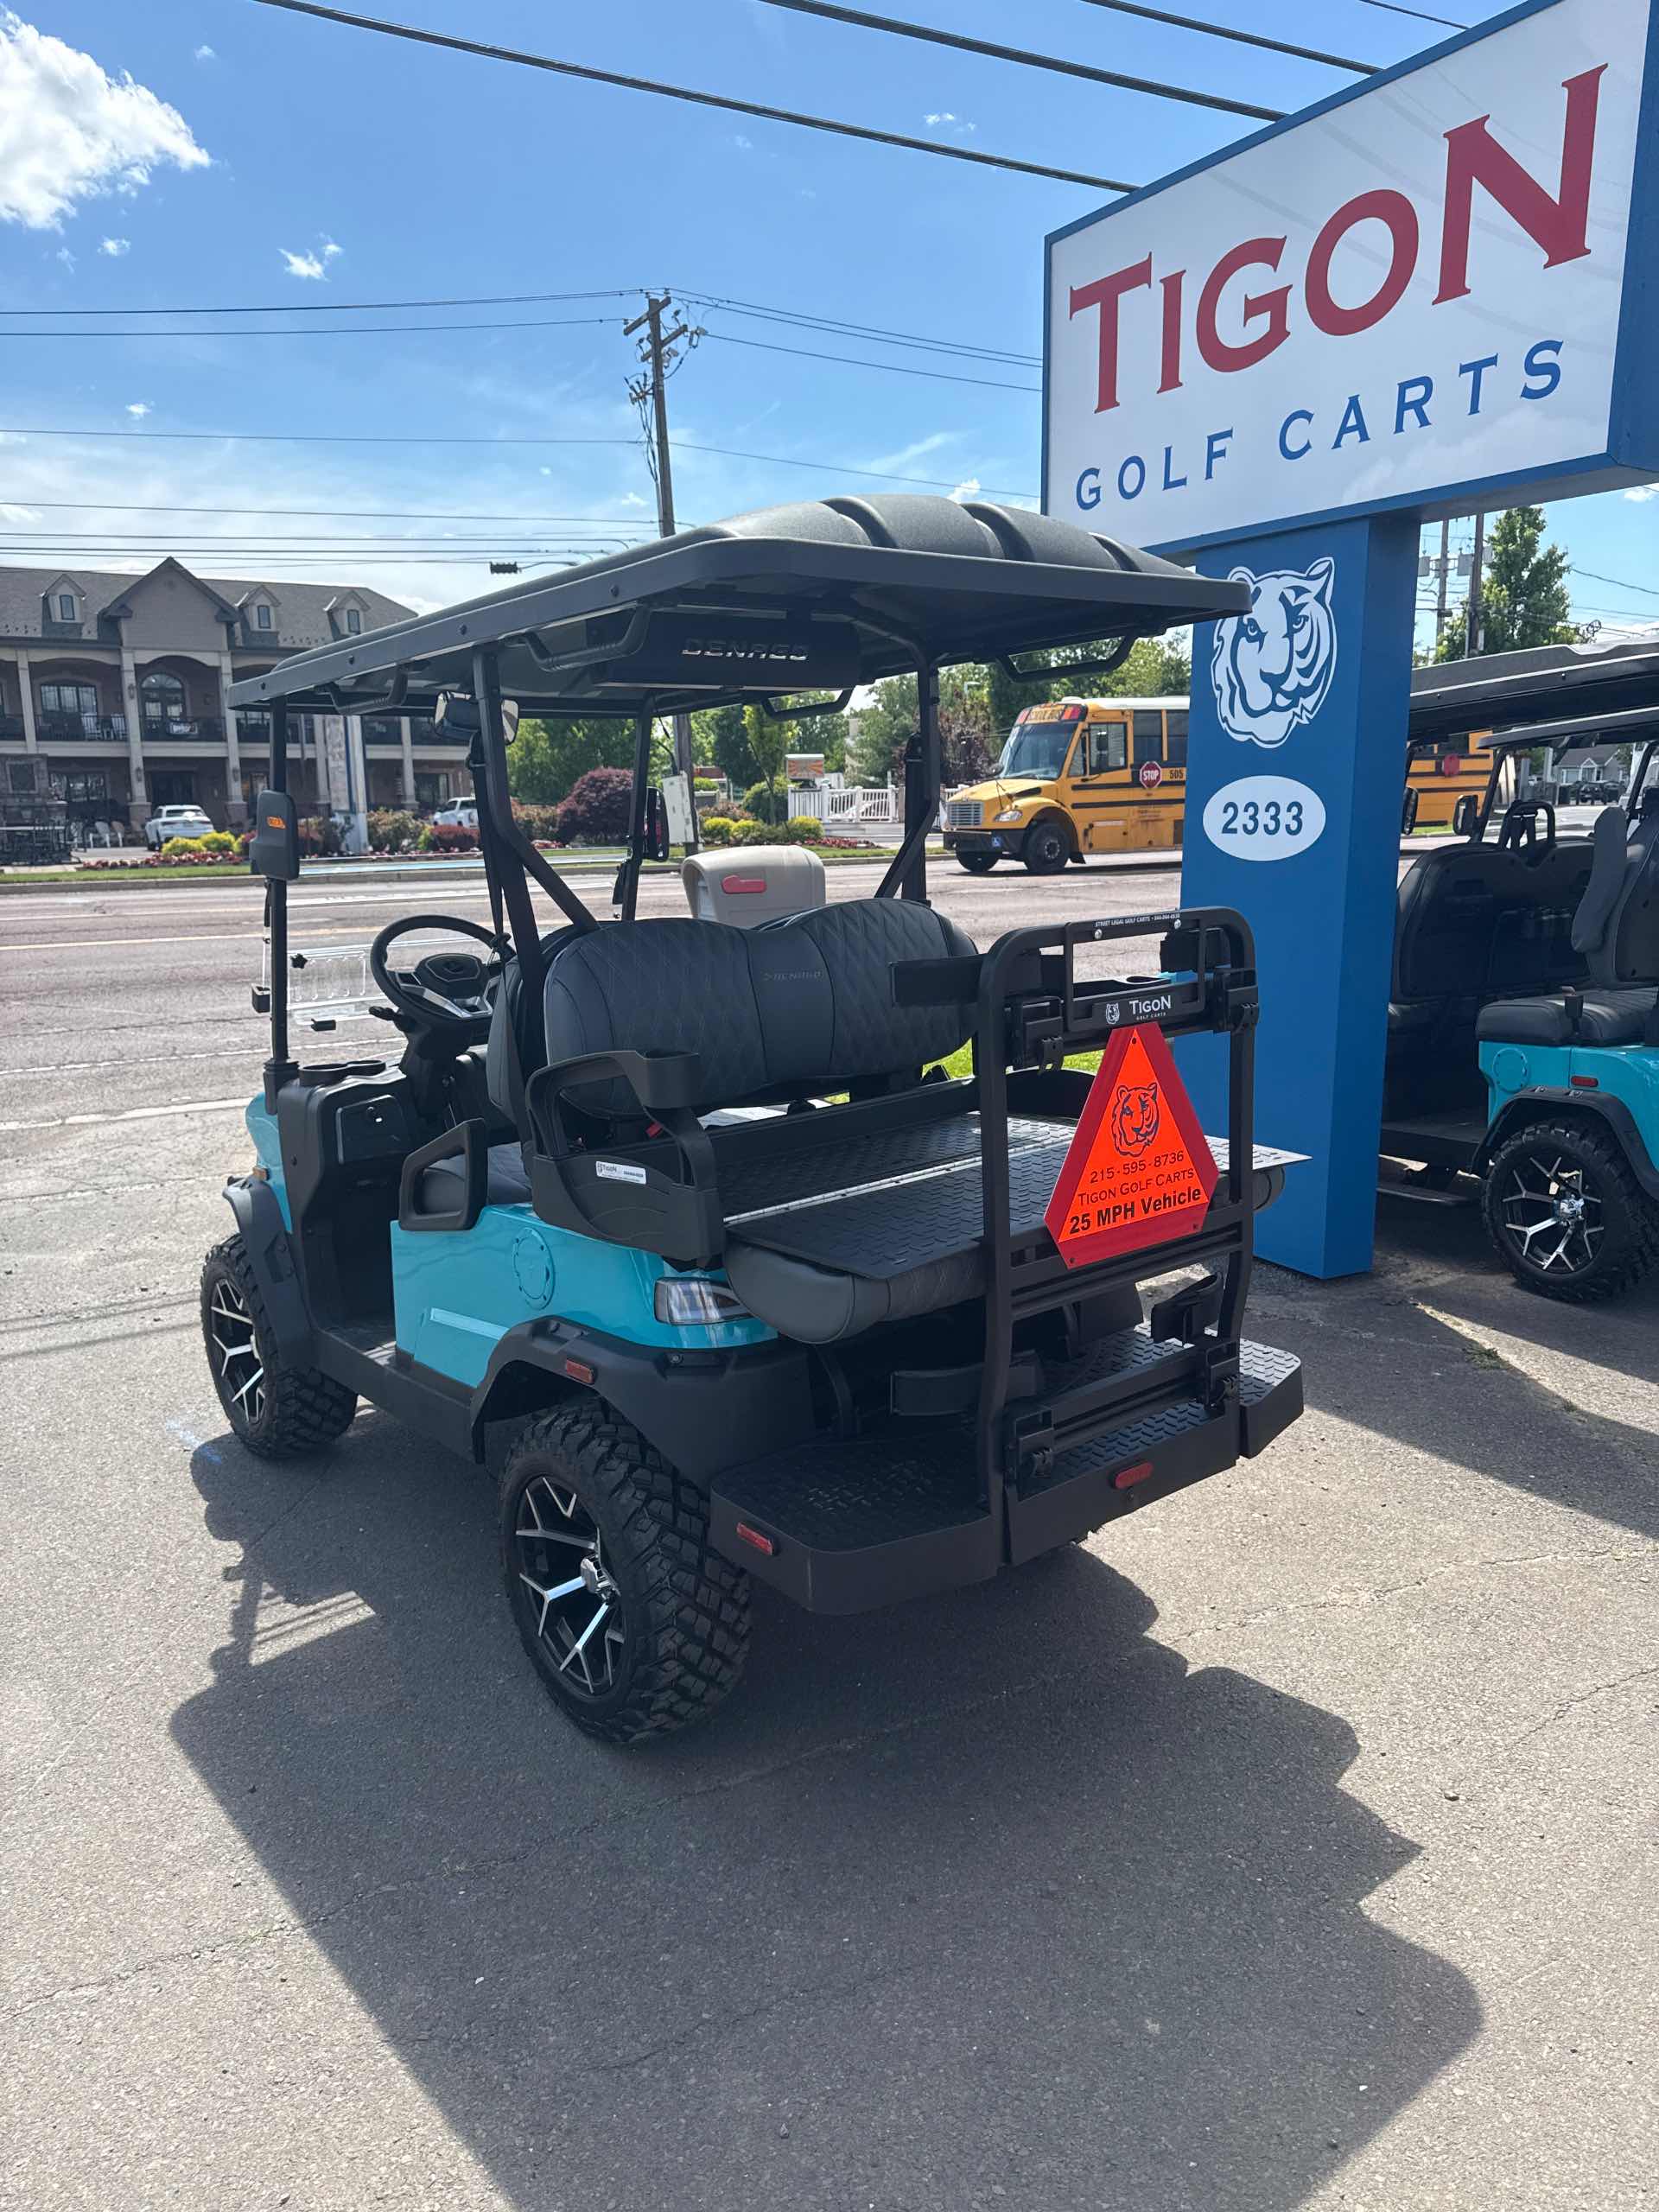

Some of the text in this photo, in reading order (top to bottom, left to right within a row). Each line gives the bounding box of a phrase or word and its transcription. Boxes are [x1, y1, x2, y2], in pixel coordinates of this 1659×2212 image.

[1070, 63, 1608, 414] TIGON
[1076, 340, 1564, 511] GOLF CARTS
[1142, 770, 1159, 781] STOP
[1221, 801, 1303, 836] 2333
[1128, 995, 1172, 1015] TIGON
[1077, 1168, 1194, 1207] TIGON GOLF CARTS
[1069, 1185, 1202, 1234] 25 MPH Vehicle
